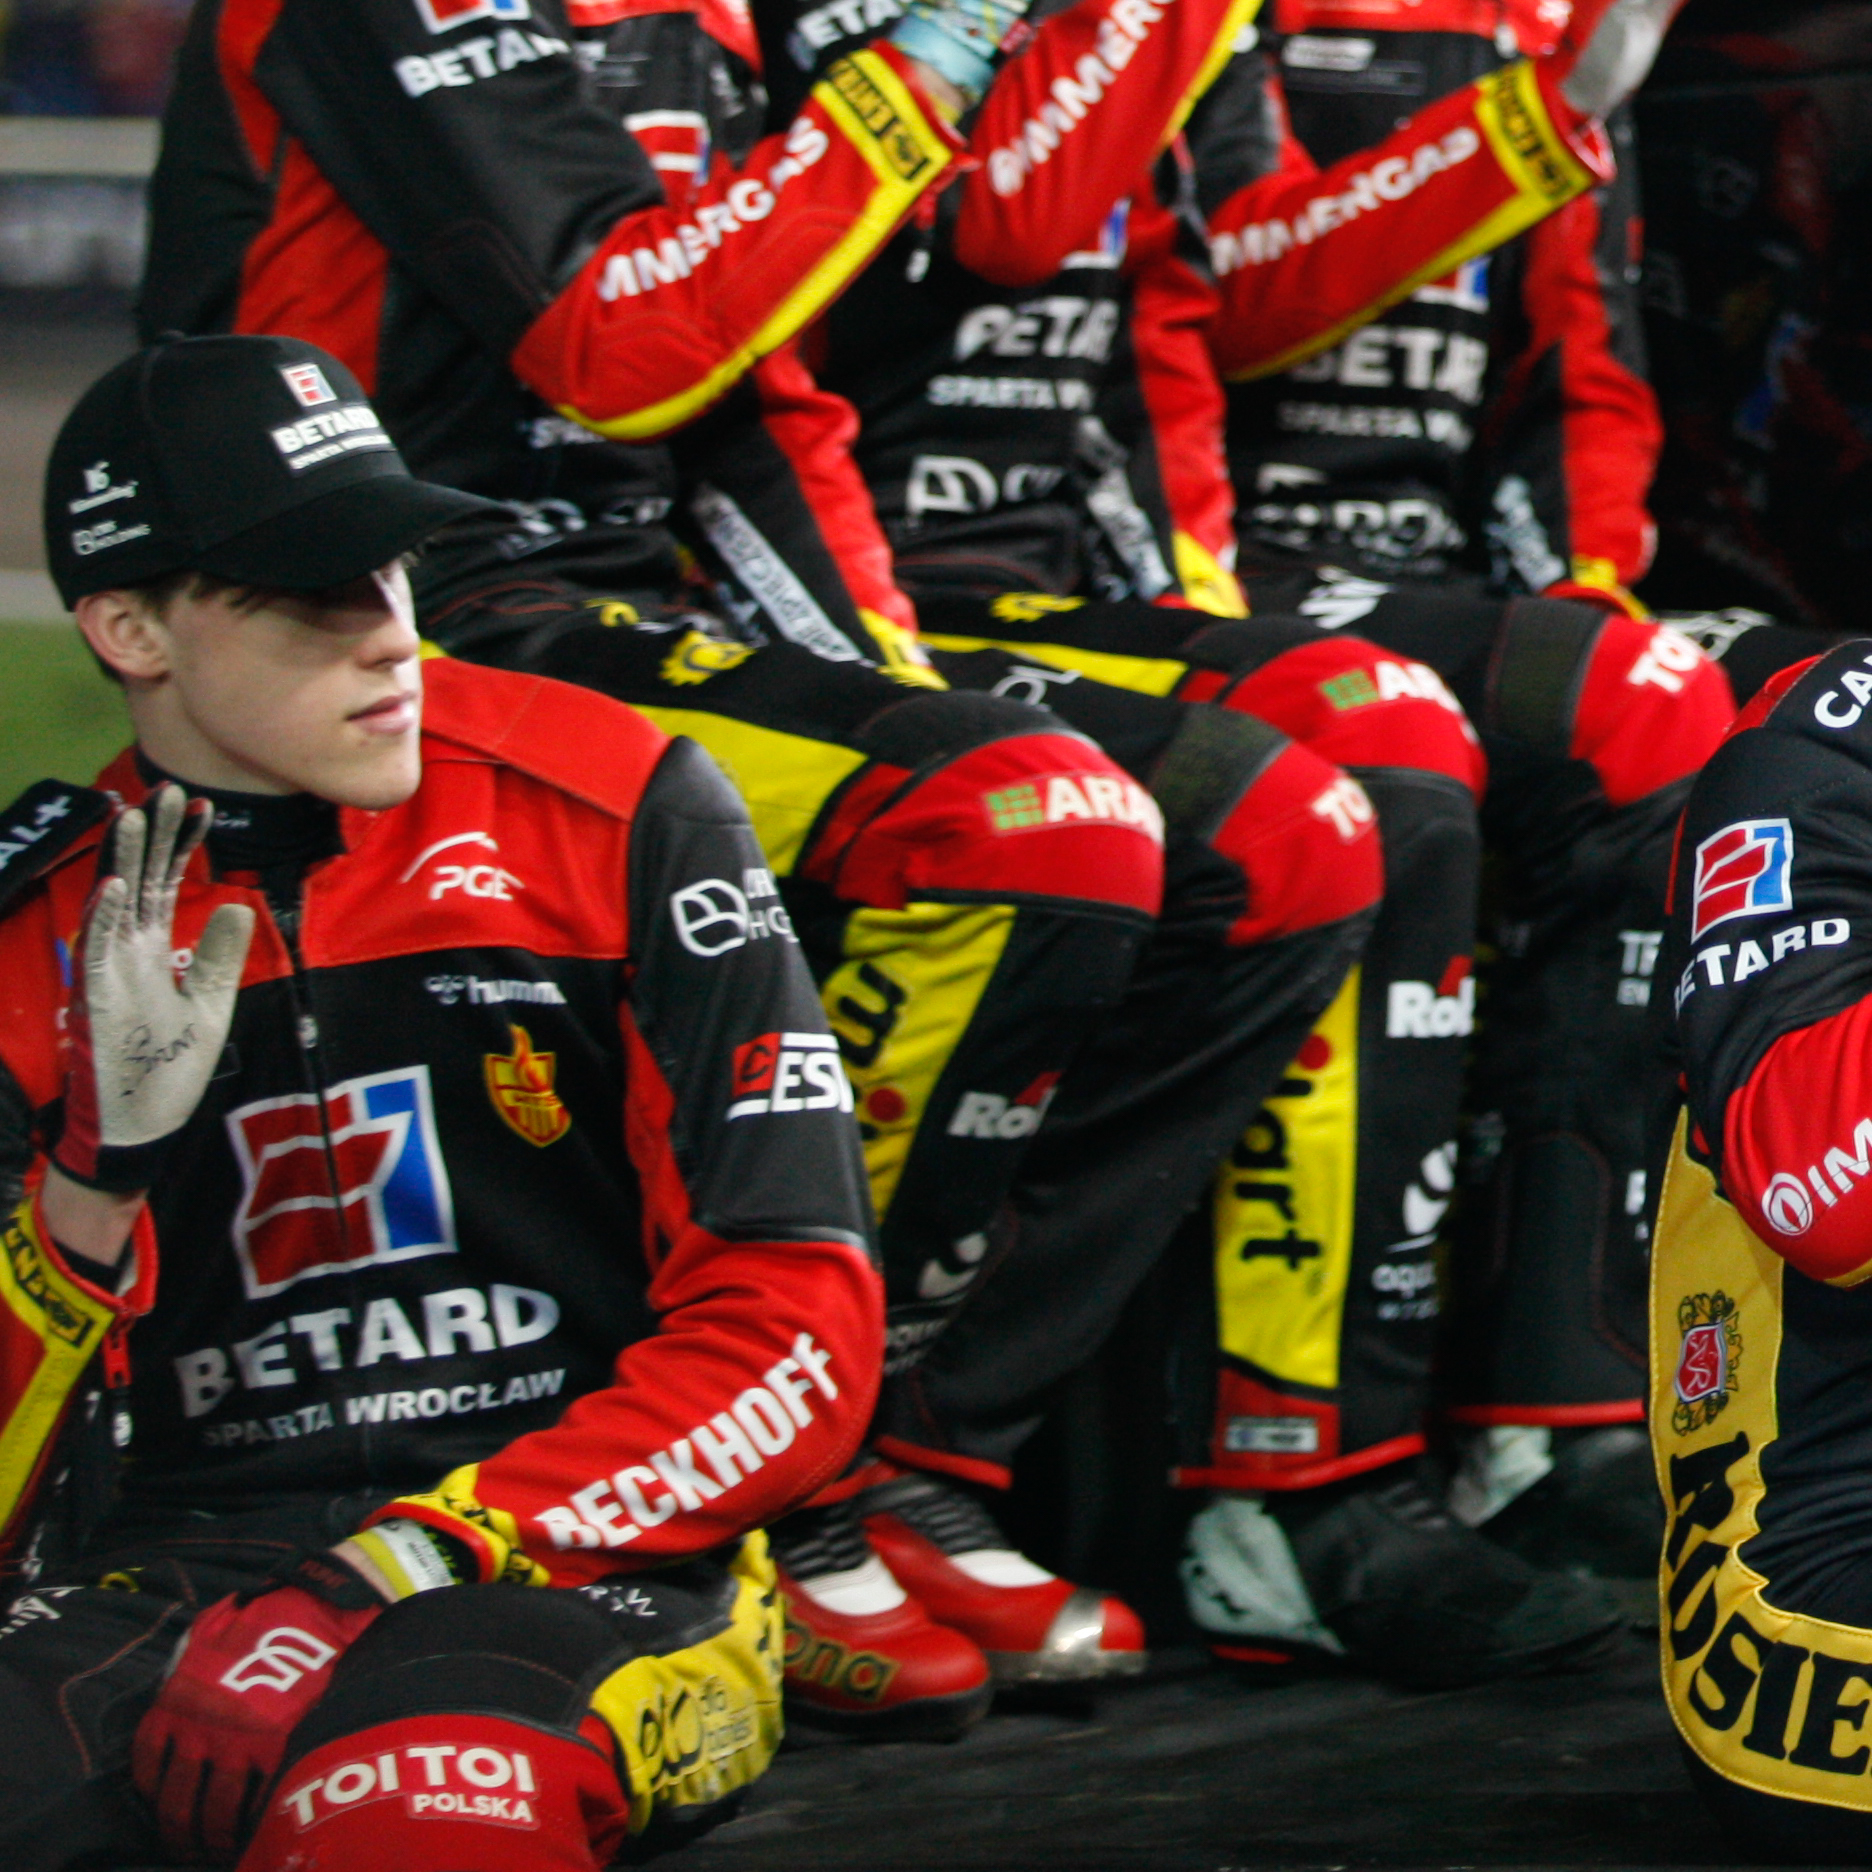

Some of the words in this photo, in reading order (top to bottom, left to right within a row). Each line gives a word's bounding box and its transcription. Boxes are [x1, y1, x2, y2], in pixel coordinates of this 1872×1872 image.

[428, 864, 515, 902] PGE
[173, 1283, 561, 1419] BETARD
[346, 1367, 567, 1426] WROCŁAW
[531, 1330, 843, 1553] BECKHOFF
[285, 1751, 403, 1828] TOI
[407, 1745, 536, 1795] TOI
[412, 1792, 534, 1825] POLSKA
